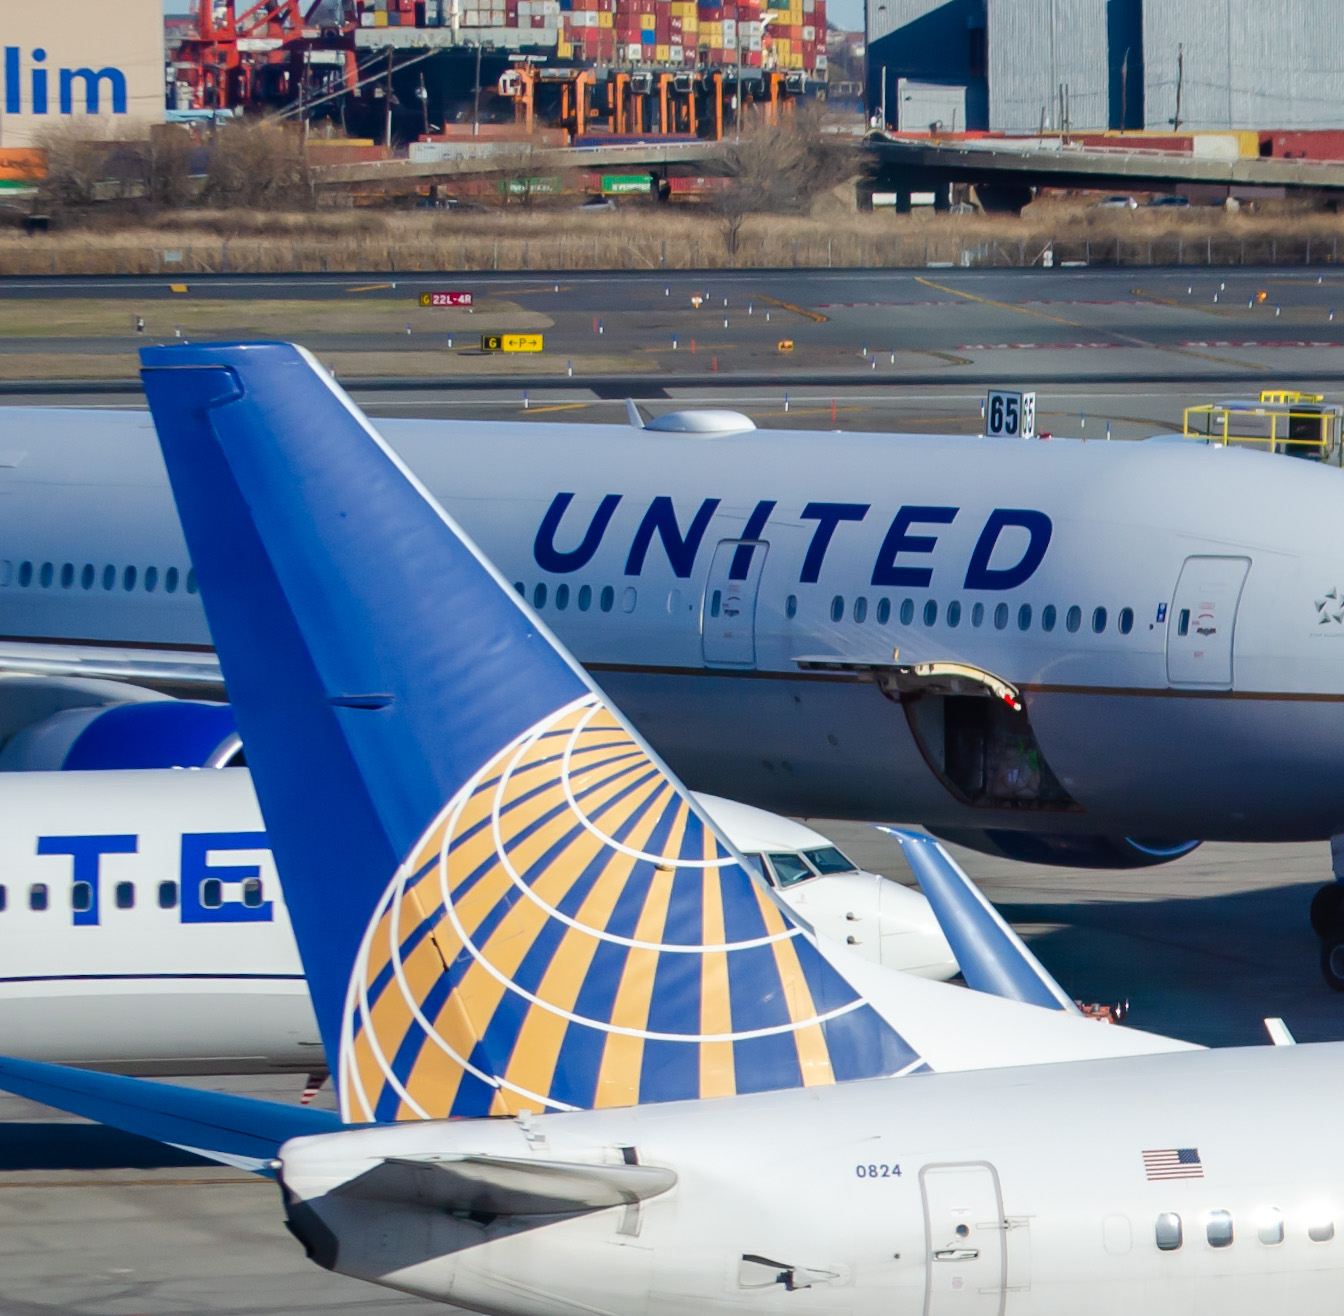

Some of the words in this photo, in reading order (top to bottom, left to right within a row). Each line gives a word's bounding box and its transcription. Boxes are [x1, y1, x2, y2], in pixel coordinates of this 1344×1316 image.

[4, 46, 127, 114] lim
[433, 294, 472, 305] 22L-4R
[489, 337, 497, 348] G
[519, 338, 527, 348] P
[991, 396, 1018, 435] 65
[1023, 397, 1034, 434] 65
[533, 492, 1054, 591] UNITED
[856, 1163, 903, 1180] 0824
